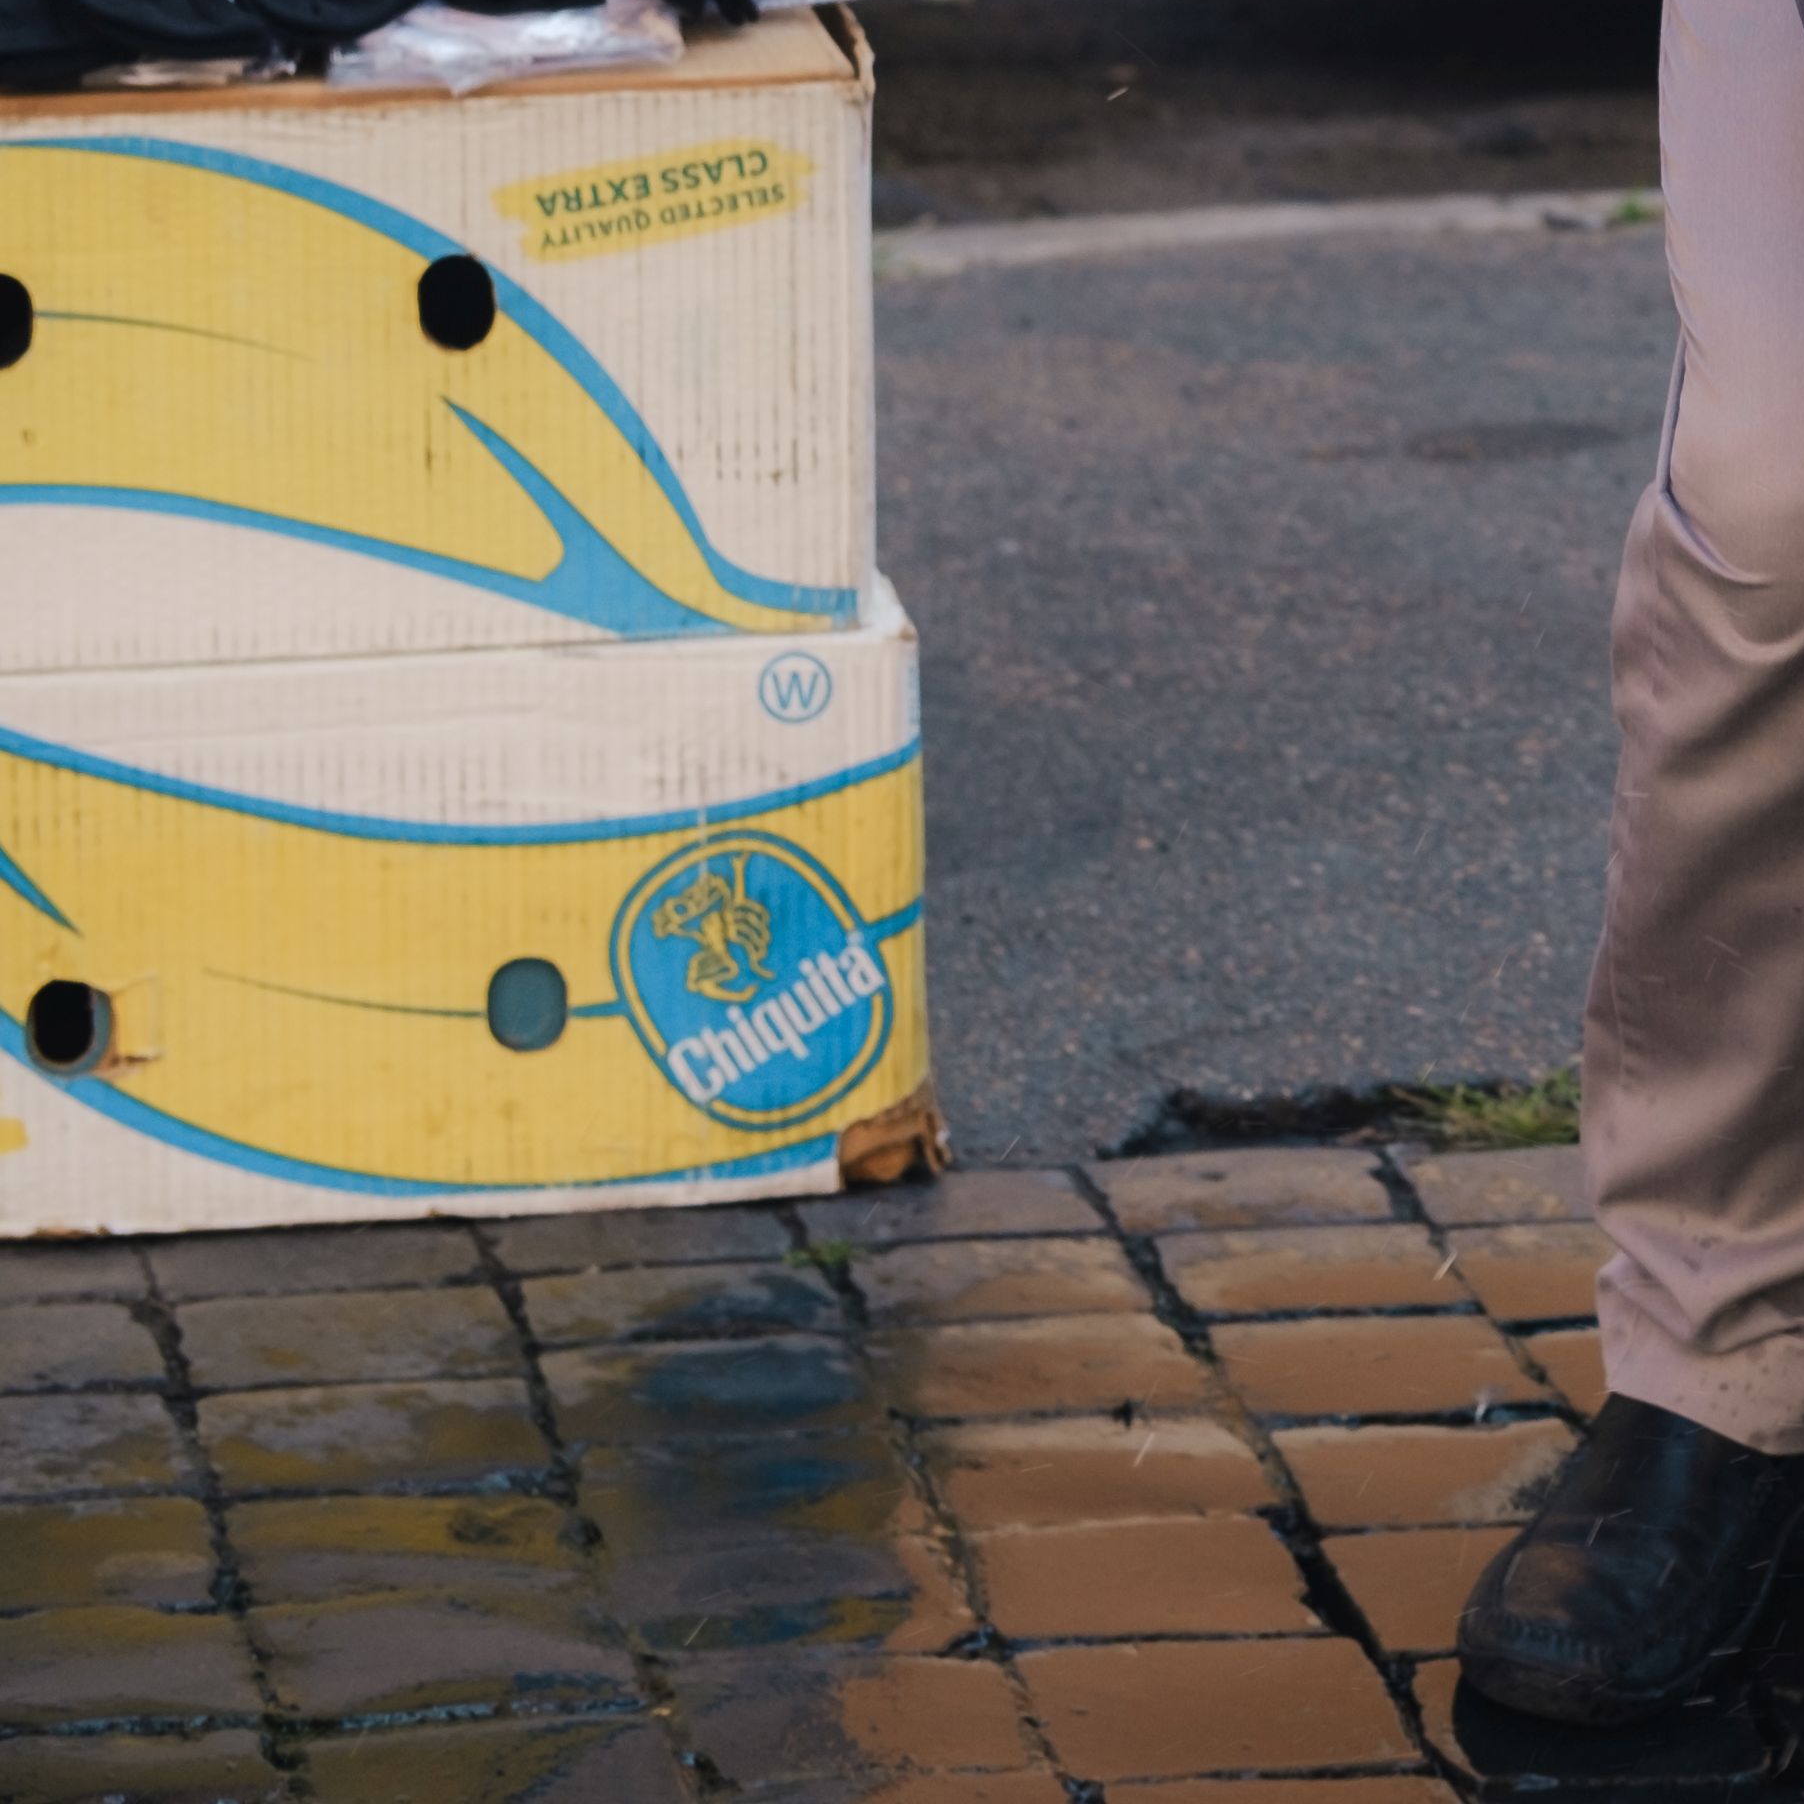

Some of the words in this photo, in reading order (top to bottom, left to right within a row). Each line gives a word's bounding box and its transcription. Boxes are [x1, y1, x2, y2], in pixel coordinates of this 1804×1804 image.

[661, 149, 768, 194] CLASS
[535, 173, 651, 218] EXTRA
[660, 183, 785, 225] SELECTED
[541, 207, 651, 251] QUALITY
[667, 944, 885, 1103] Chiquita
